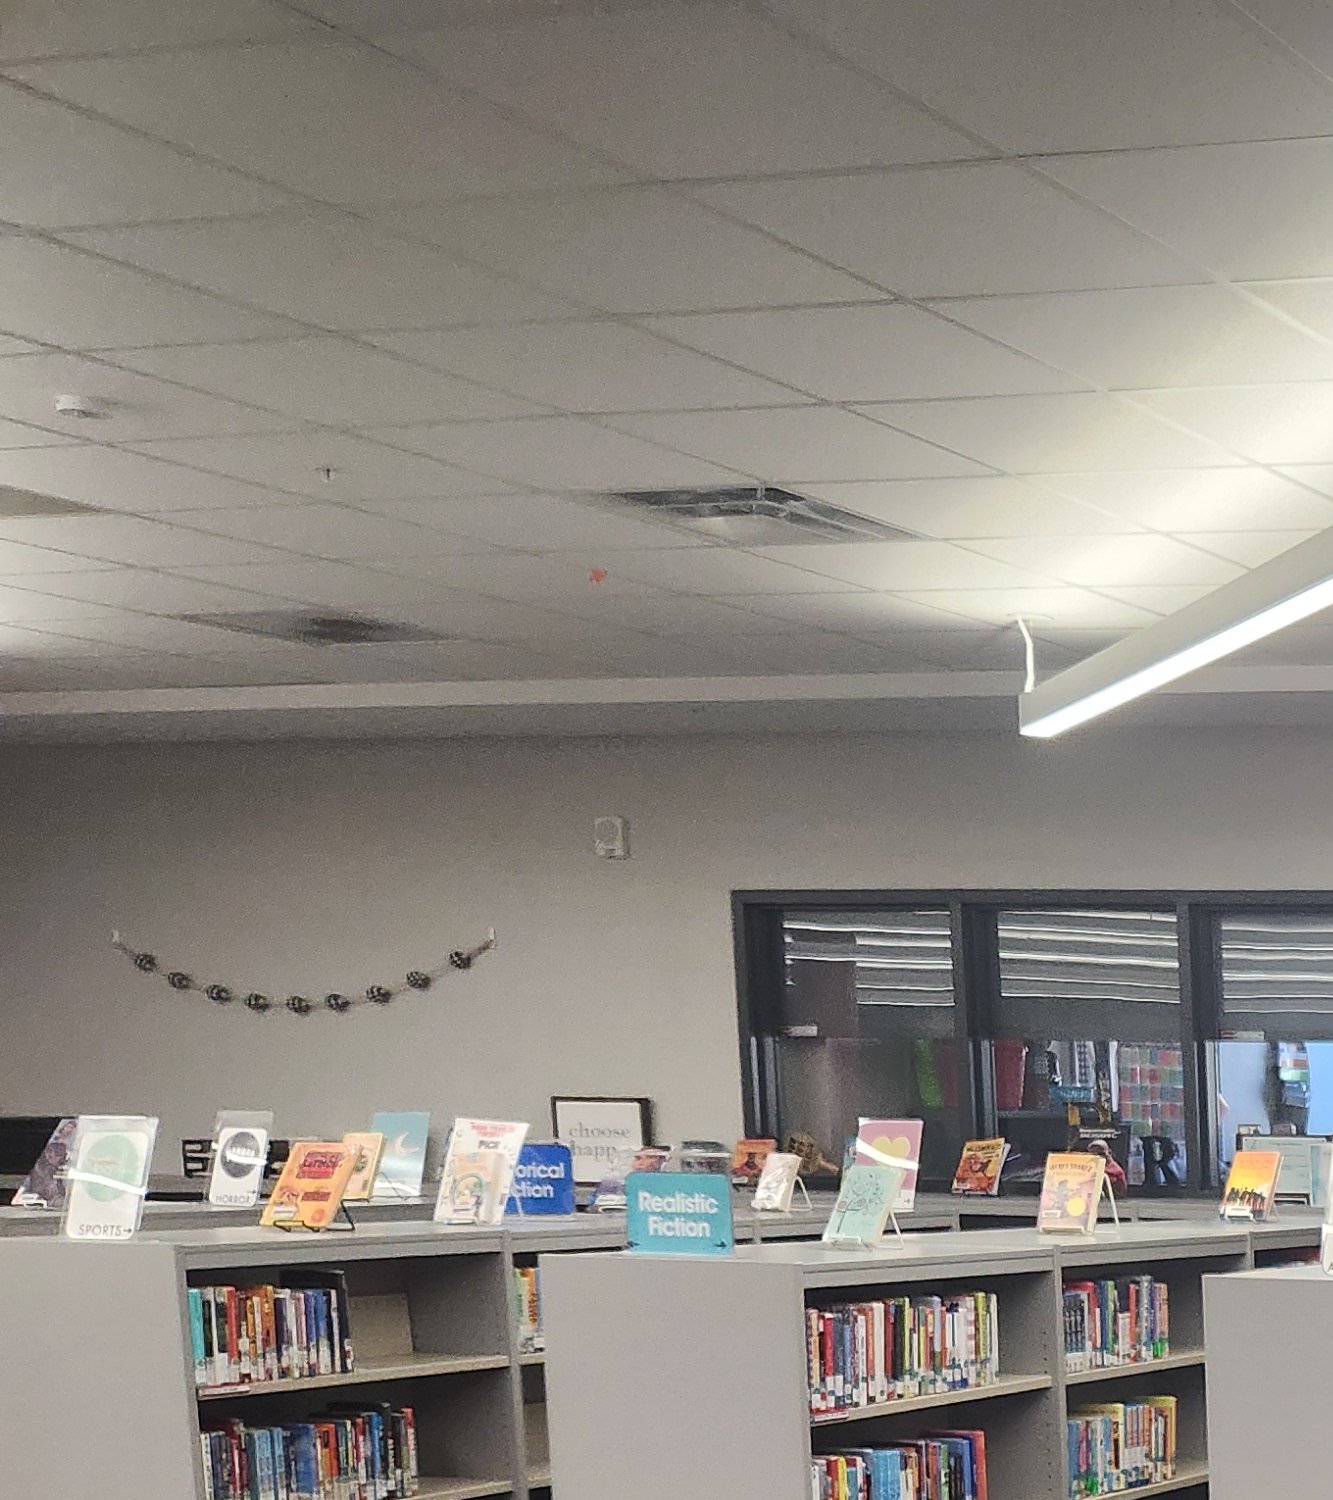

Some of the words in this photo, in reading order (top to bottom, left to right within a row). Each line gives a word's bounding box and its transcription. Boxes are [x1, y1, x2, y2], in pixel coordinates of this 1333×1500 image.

[568, 1121, 631, 1139] choose
[570, 1140, 626, 1161] happ
[513, 1162, 565, 1179] orical
[510, 1180, 554, 1198] ction
[637, 1190, 719, 1214] Realistic
[78, 1224, 123, 1237] SPORTS
[647, 1217, 711, 1238] Fiction
